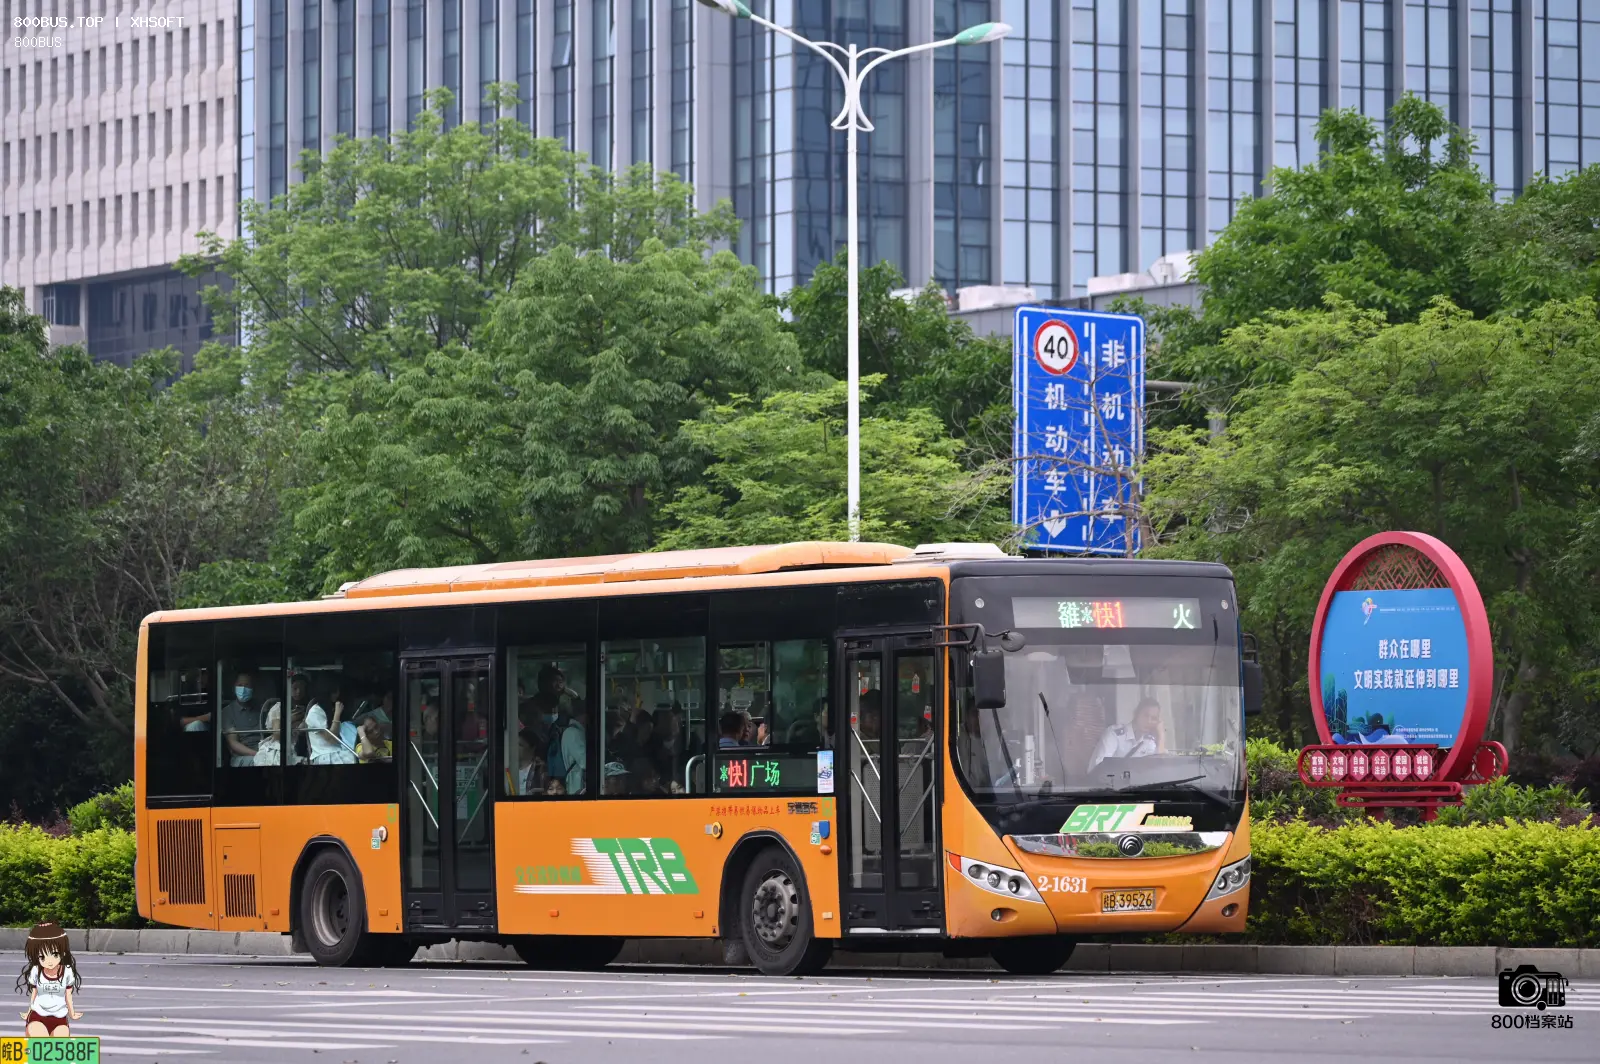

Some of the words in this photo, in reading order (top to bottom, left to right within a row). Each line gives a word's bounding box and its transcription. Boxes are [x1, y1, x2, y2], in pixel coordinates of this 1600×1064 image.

[1043, 335, 1069, 359] 40
[1044, 382, 1068, 495] 机动车
[1173, 603, 1195, 629] 火
[1378, 638, 1431, 660] 群众在哪里
[1353, 667, 1459, 690] 文明实践就延伸到哪里
[750, 760, 780, 787] 广场
[1059, 804, 1137, 832] BRT
[1037, 875, 1089, 894] 2-1631
